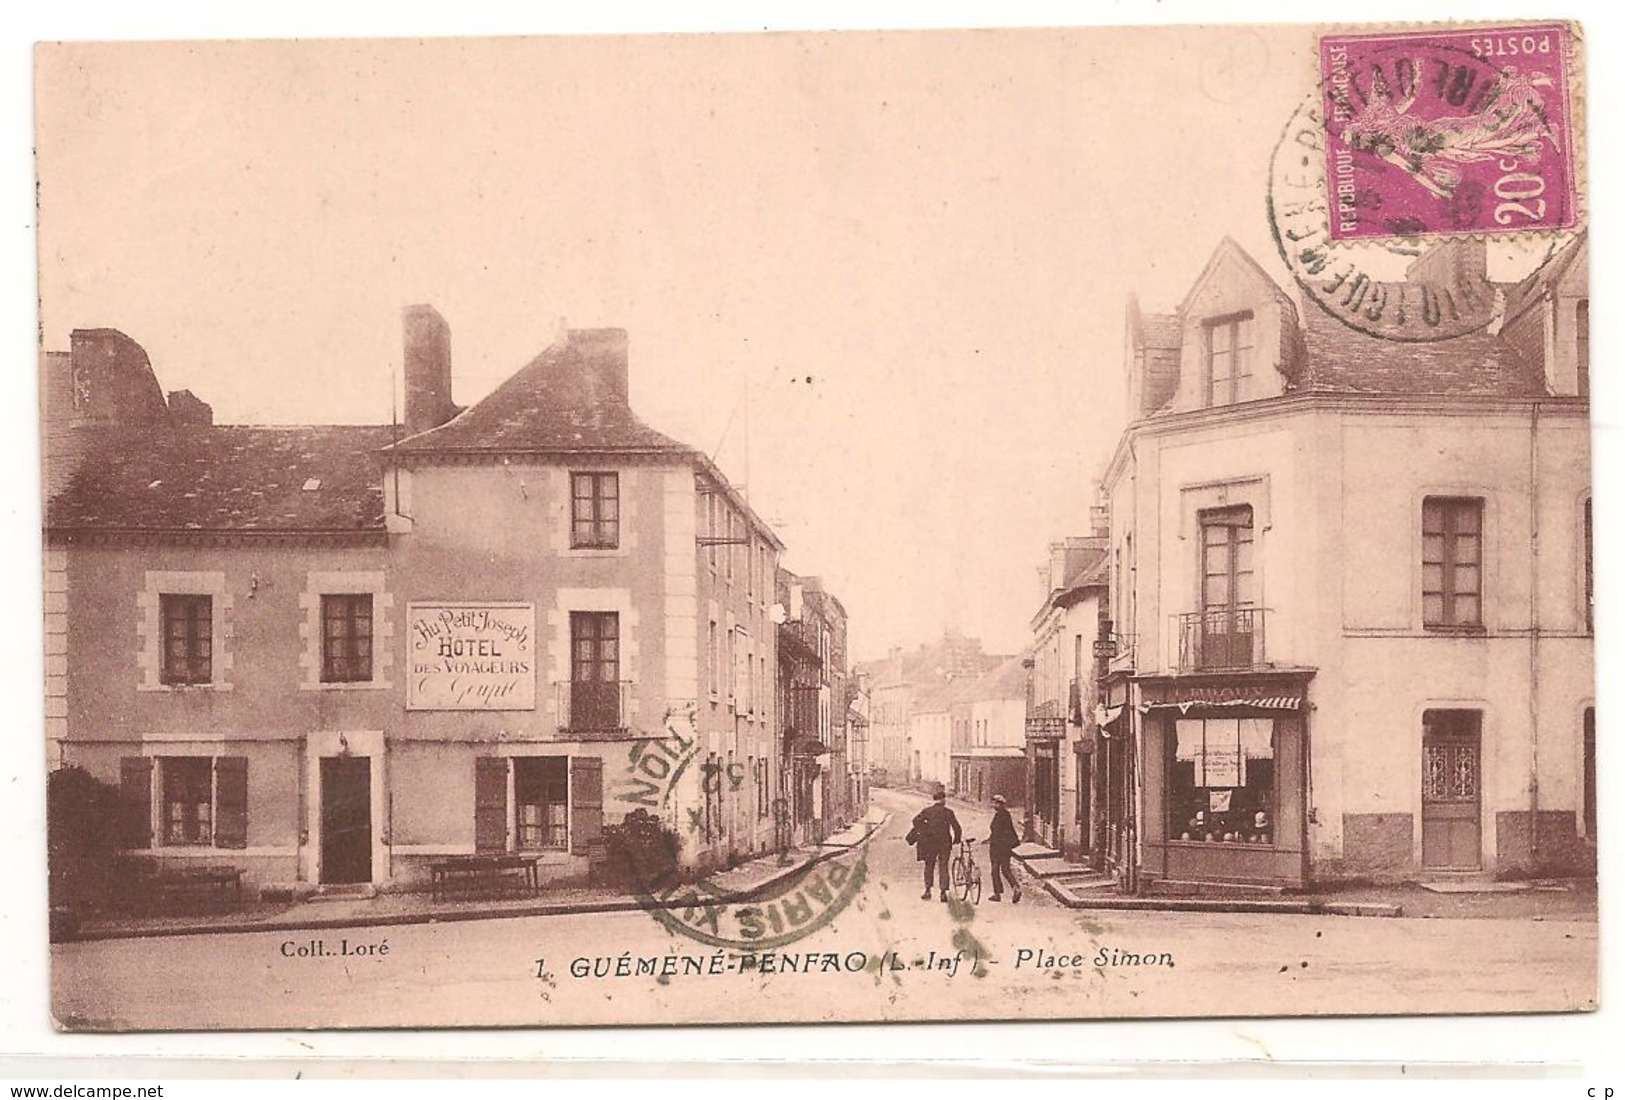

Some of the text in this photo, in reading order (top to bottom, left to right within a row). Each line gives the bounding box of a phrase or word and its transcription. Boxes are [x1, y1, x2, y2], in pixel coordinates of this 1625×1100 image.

[1471, 35, 1551, 56] POSTES
[1336, 149, 1358, 232] REPUBLIQUE
[413, 610, 527, 651] Au Petit Joseph
[414, 659, 529, 674] DES VOYAGEURS
[733, 860, 852, 938] PARIS
